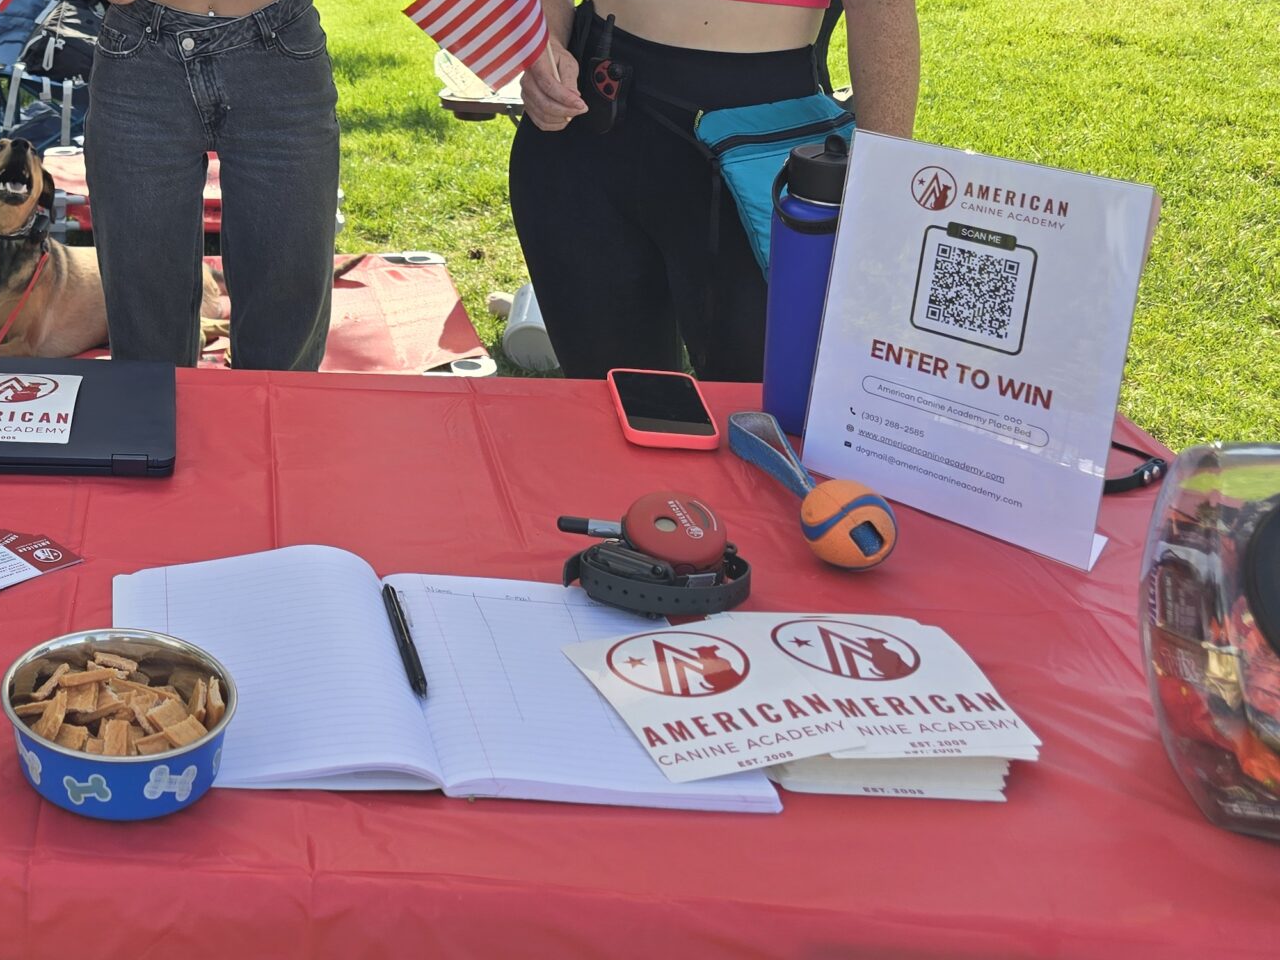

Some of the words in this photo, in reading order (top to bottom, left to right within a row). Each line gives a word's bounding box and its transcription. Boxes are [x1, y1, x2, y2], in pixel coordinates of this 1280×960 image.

[963, 181, 1069, 218] AMERICAN
[960, 201, 1003, 218] CANINE
[1007, 211, 1066, 231] ACADEMY
[961, 228, 987, 241] SCAN
[987, 233, 1002, 244] ME
[870, 338, 949, 380] ENTER
[956, 362, 990, 390] TO
[997, 375, 1053, 410] WIN
[861, 410, 883, 425] (303)
[876, 384, 916, 404] American
[916, 396, 946, 411] Canine
[946, 405, 987, 425] Academy
[988, 418, 1013, 433] Place
[1014, 425, 1032, 439] Bed
[857, 428, 1006, 485] www.americancanineacademy.com
[855, 444, 1023, 509] dogmail@americancanineacademy.com
[18, 540, 51, 553] AMERICAN
[832, 691, 1007, 718] MERICAN
[641, 693, 833, 748] AMERICAN
[856, 723, 913, 737] NINE
[919, 718, 1020, 734] ACADEMY
[658, 742, 740, 766] CANINE
[746, 719, 845, 750] ACADEMY
[938, 739, 967, 747] 2005
[737, 759, 763, 769] EST.
[766, 750, 794, 762] 2005
[862, 786, 890, 794] EST.
[893, 787, 925, 795] 2005
